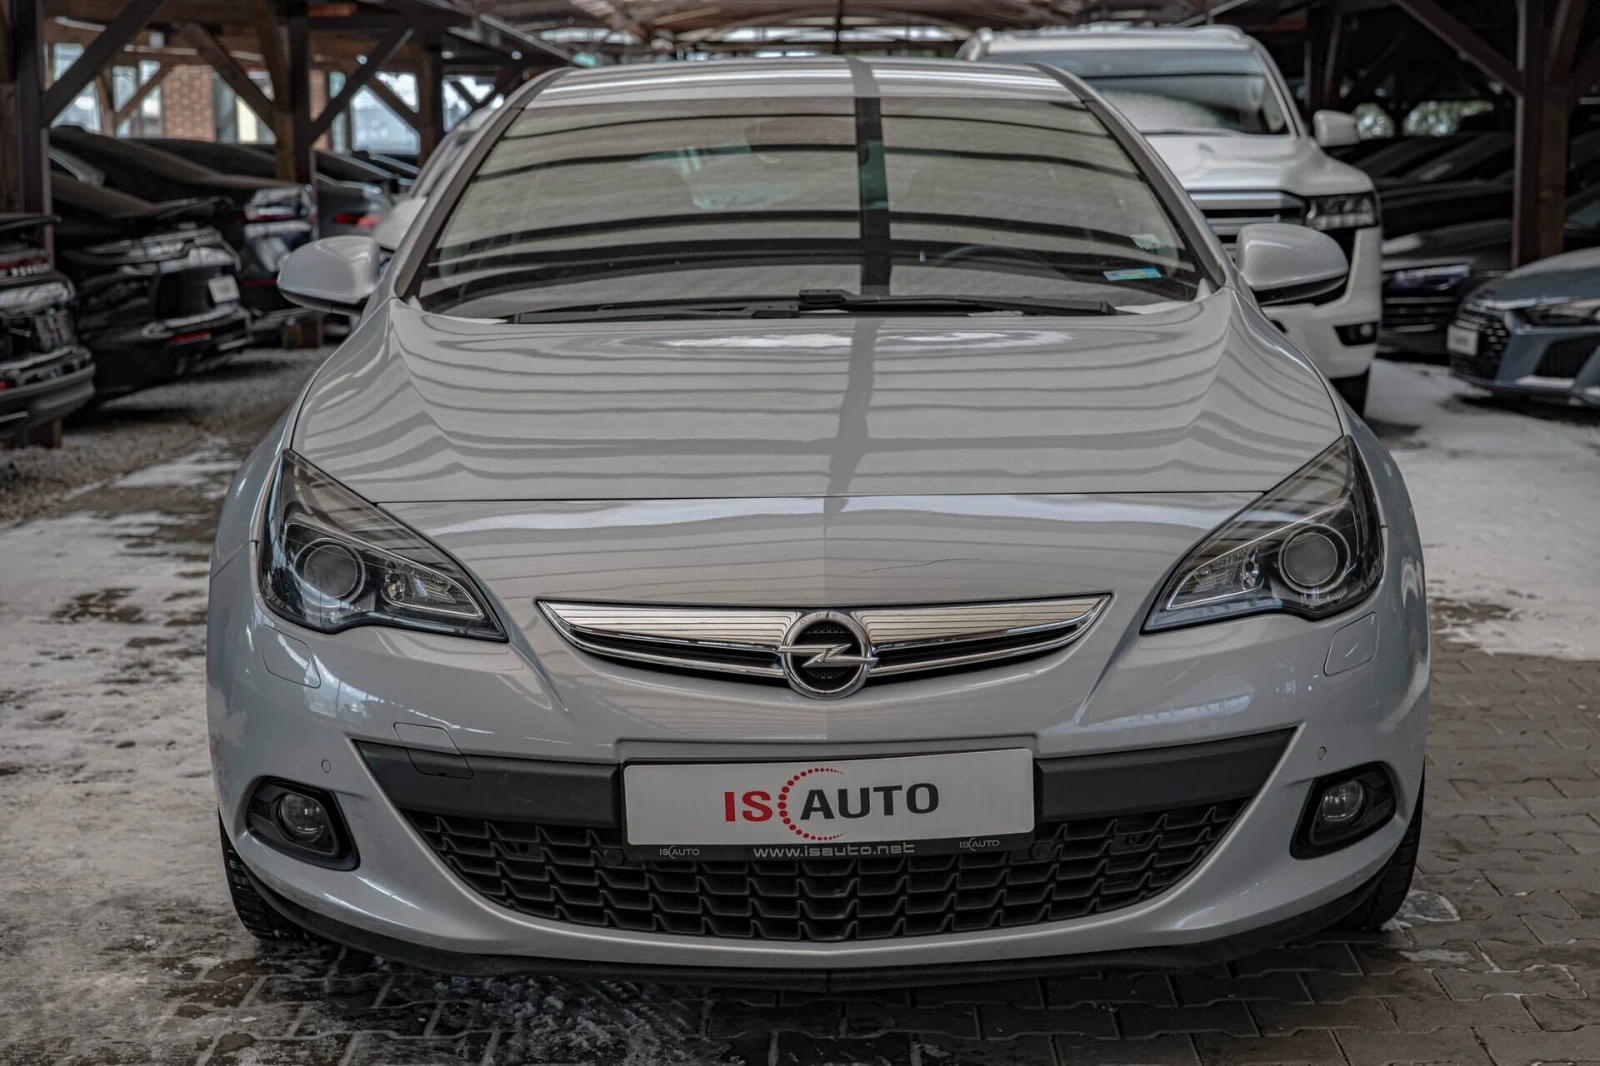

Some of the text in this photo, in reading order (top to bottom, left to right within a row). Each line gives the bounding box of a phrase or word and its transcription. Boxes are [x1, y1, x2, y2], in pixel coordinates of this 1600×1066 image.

[724, 783, 940, 822] IS AUTO
[753, 842, 916, 857] www.isauto.net
